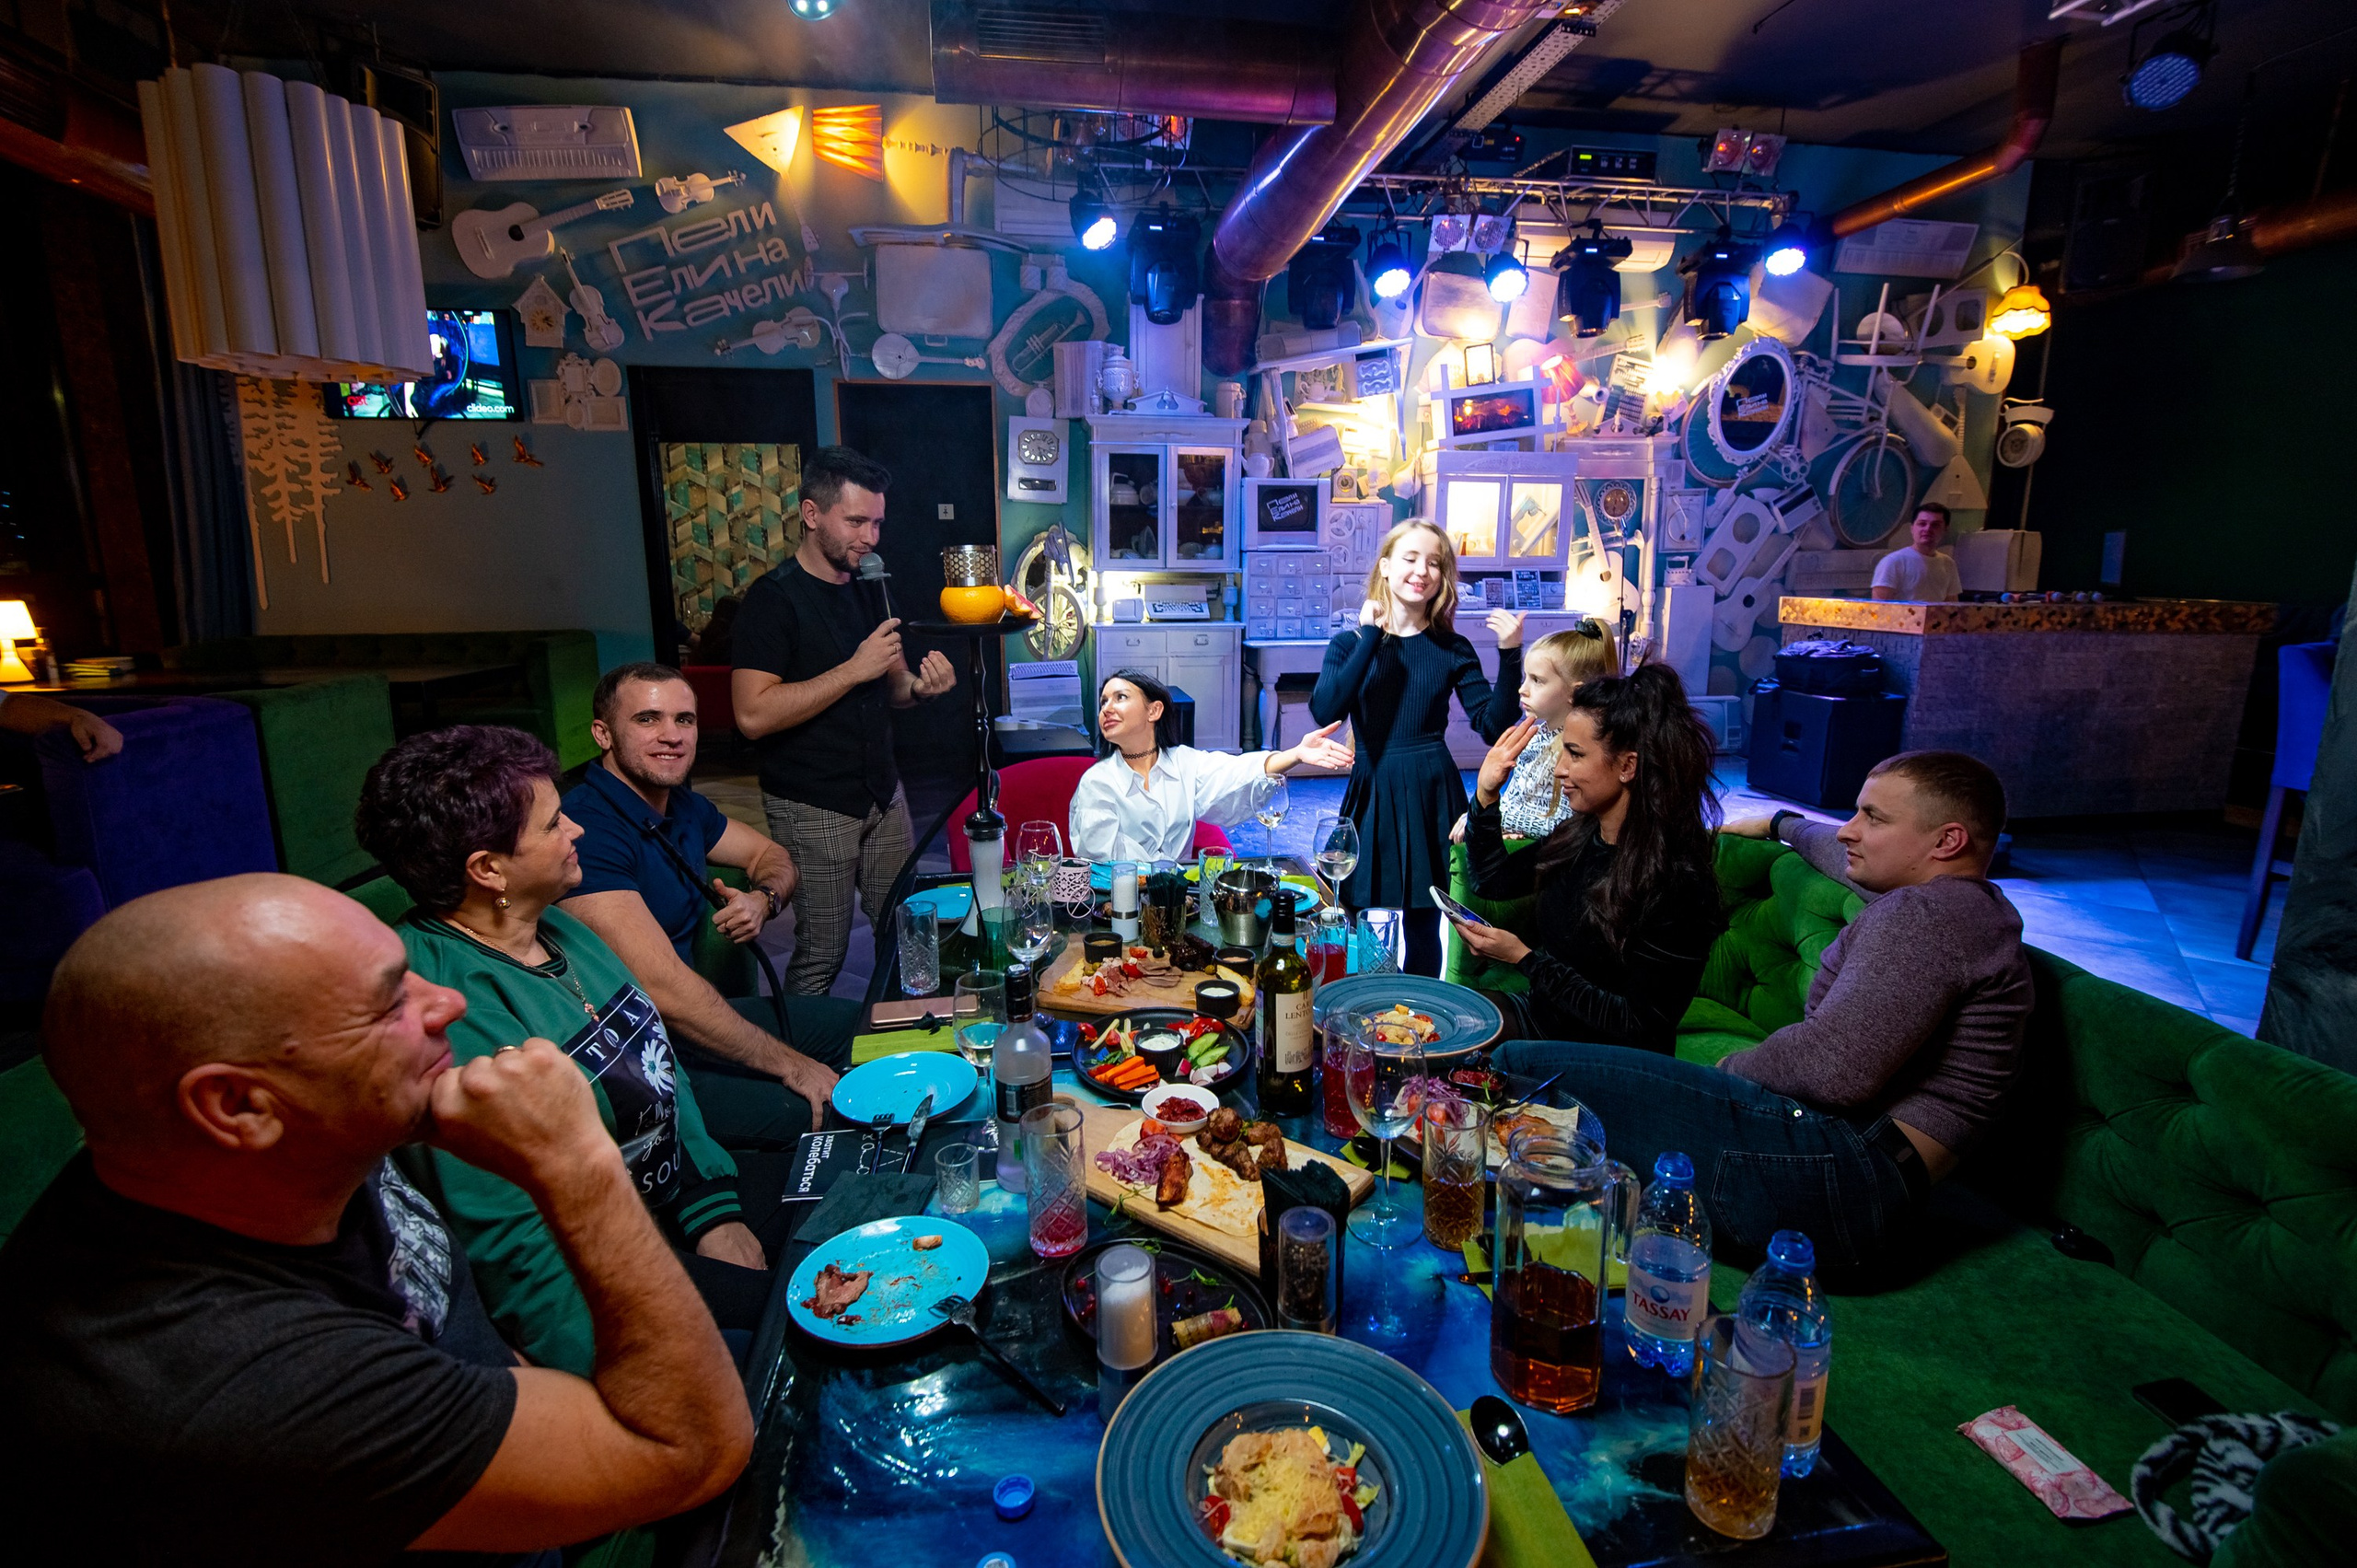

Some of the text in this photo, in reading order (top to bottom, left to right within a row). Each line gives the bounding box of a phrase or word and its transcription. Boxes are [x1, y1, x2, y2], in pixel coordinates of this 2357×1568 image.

[608, 201, 777, 273] Пели
[621, 237, 790, 308] Ели на
[635, 268, 807, 343] Качели
[466, 403, 515, 414] clideo.com
[797, 1135, 825, 1193] колебаться
[820, 1134, 835, 1159] хватит
[1631, 1289, 1691, 1321] TASSAY
